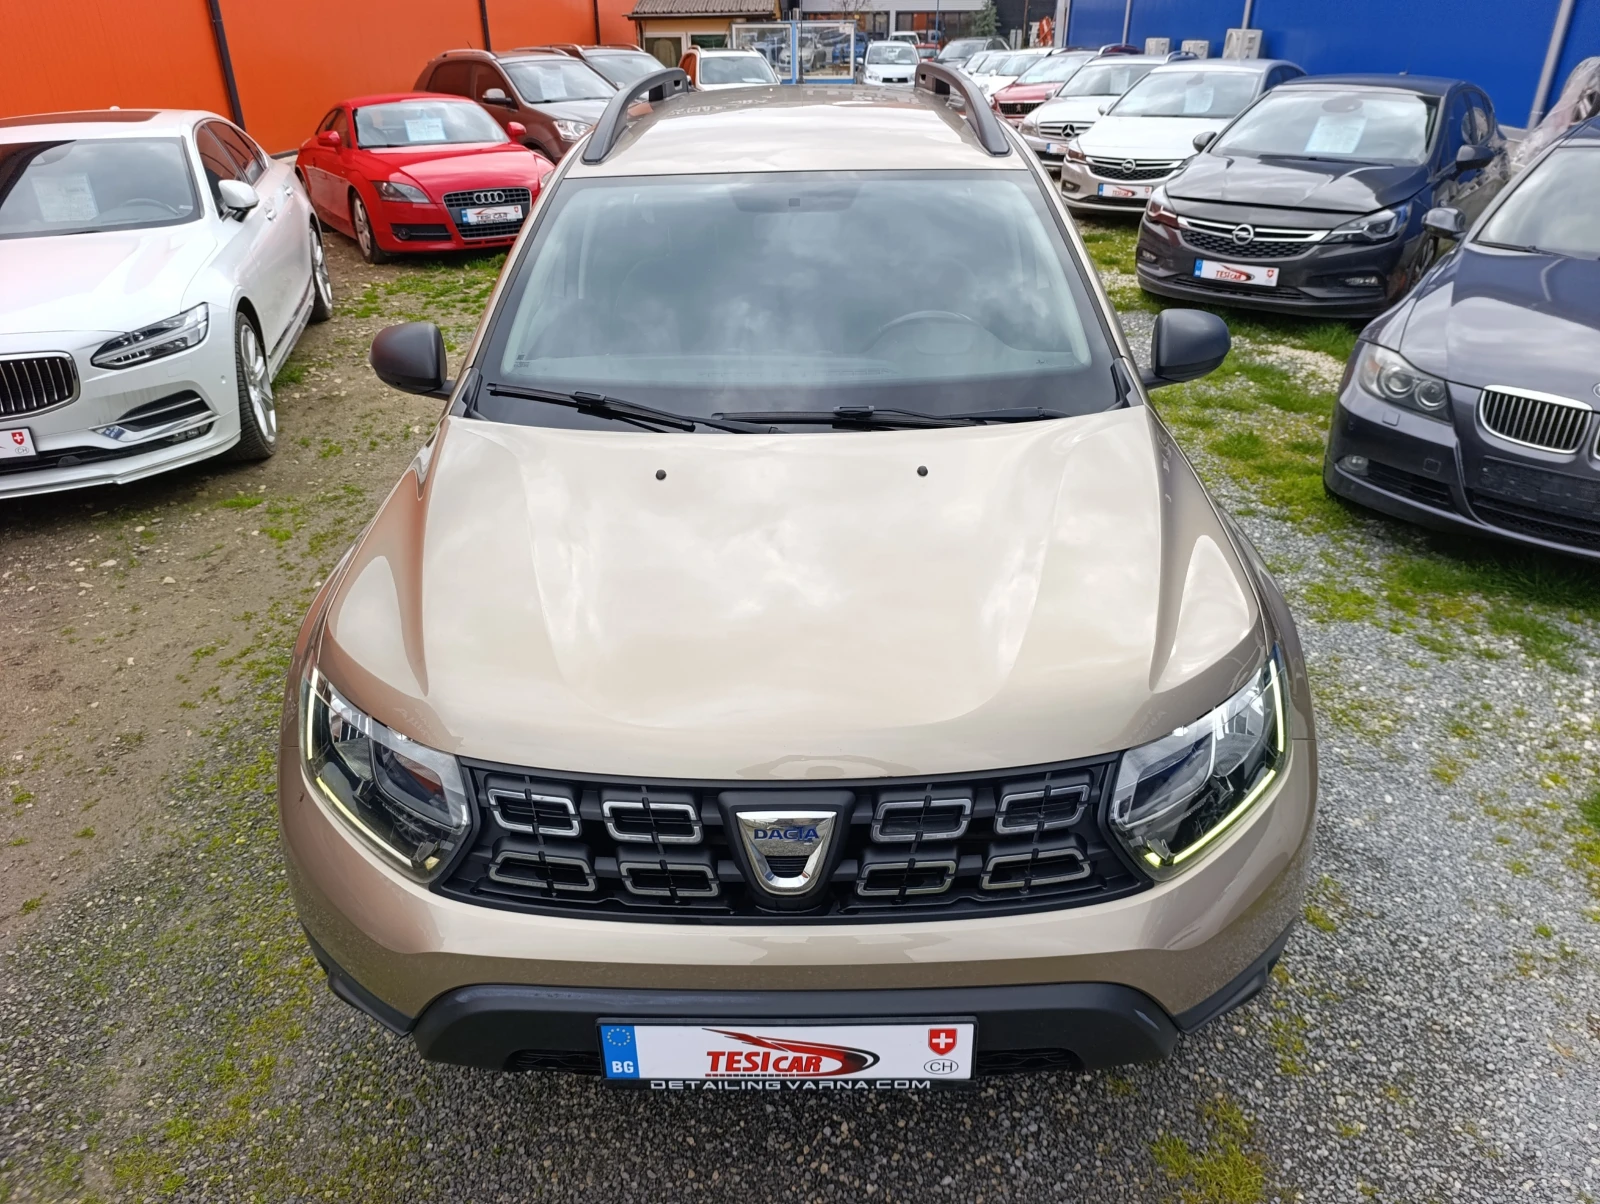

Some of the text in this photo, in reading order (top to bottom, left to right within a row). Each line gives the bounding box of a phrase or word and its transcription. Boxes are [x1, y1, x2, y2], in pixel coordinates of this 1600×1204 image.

[754, 827, 819, 840] DACIA
[612, 1060, 634, 1073] BG
[929, 1061, 953, 1072] CH
